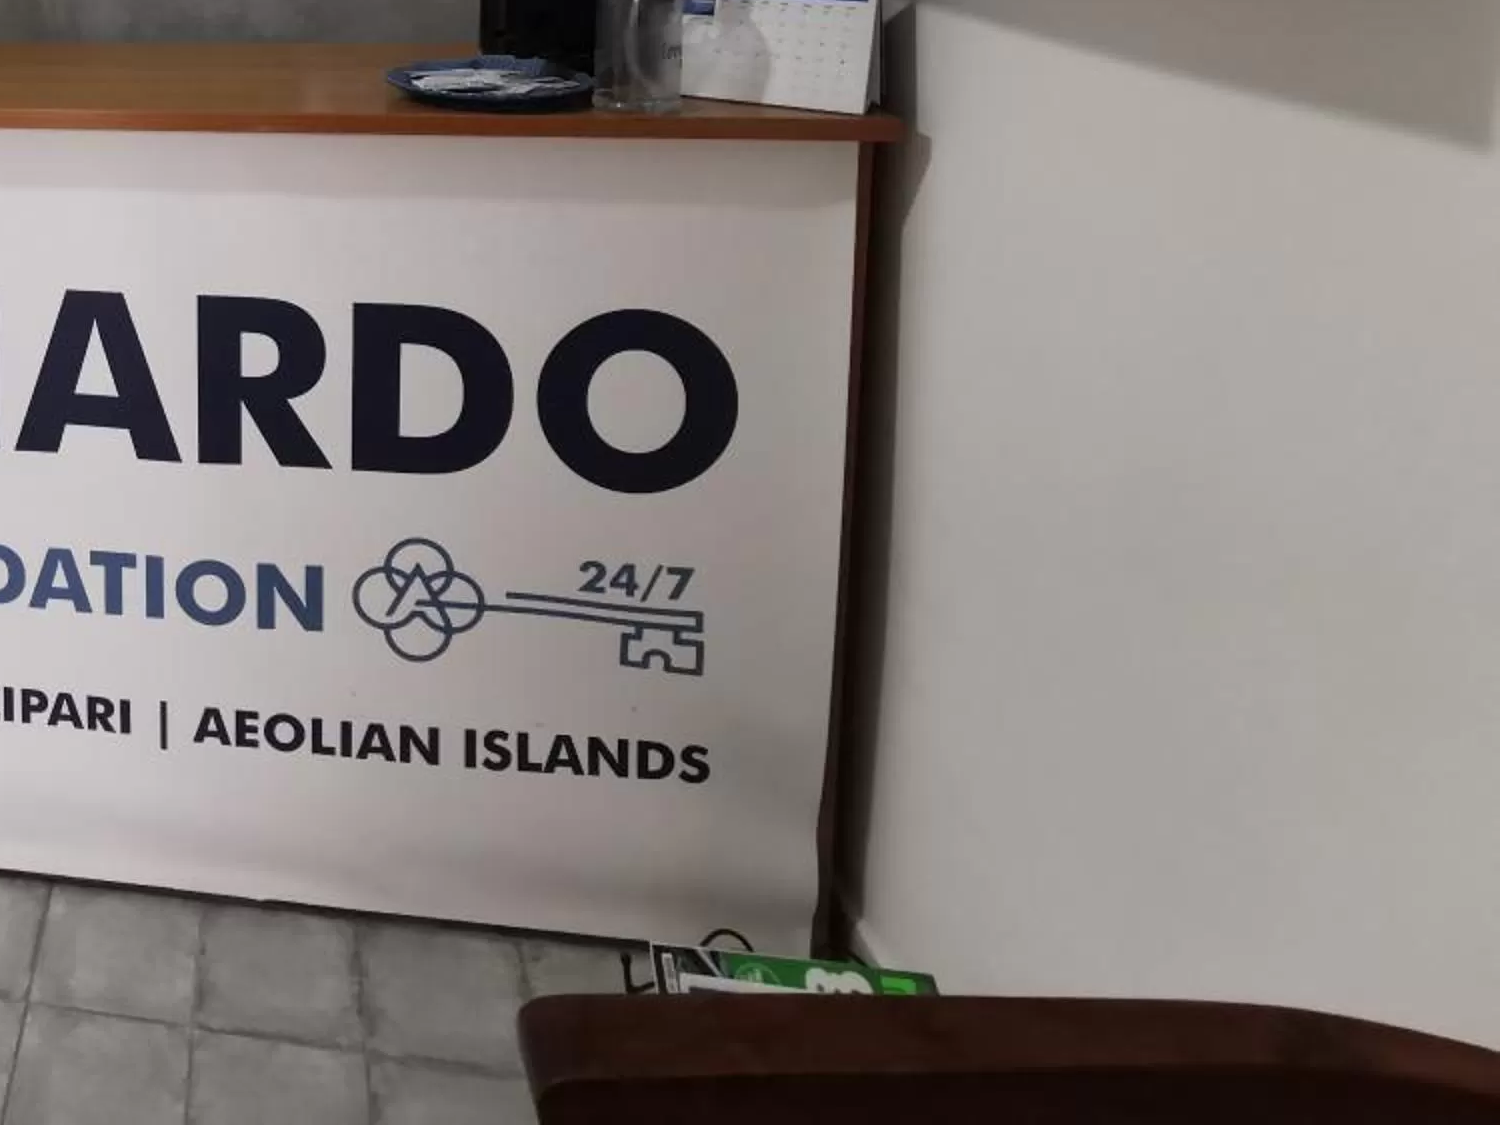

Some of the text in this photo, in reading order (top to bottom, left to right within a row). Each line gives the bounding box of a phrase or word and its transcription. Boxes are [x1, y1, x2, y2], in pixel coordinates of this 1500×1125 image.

[576, 559, 697, 604] 24/7
[193, 706, 441, 767] AEOLIAN
[463, 727, 711, 784] ISLANDS
